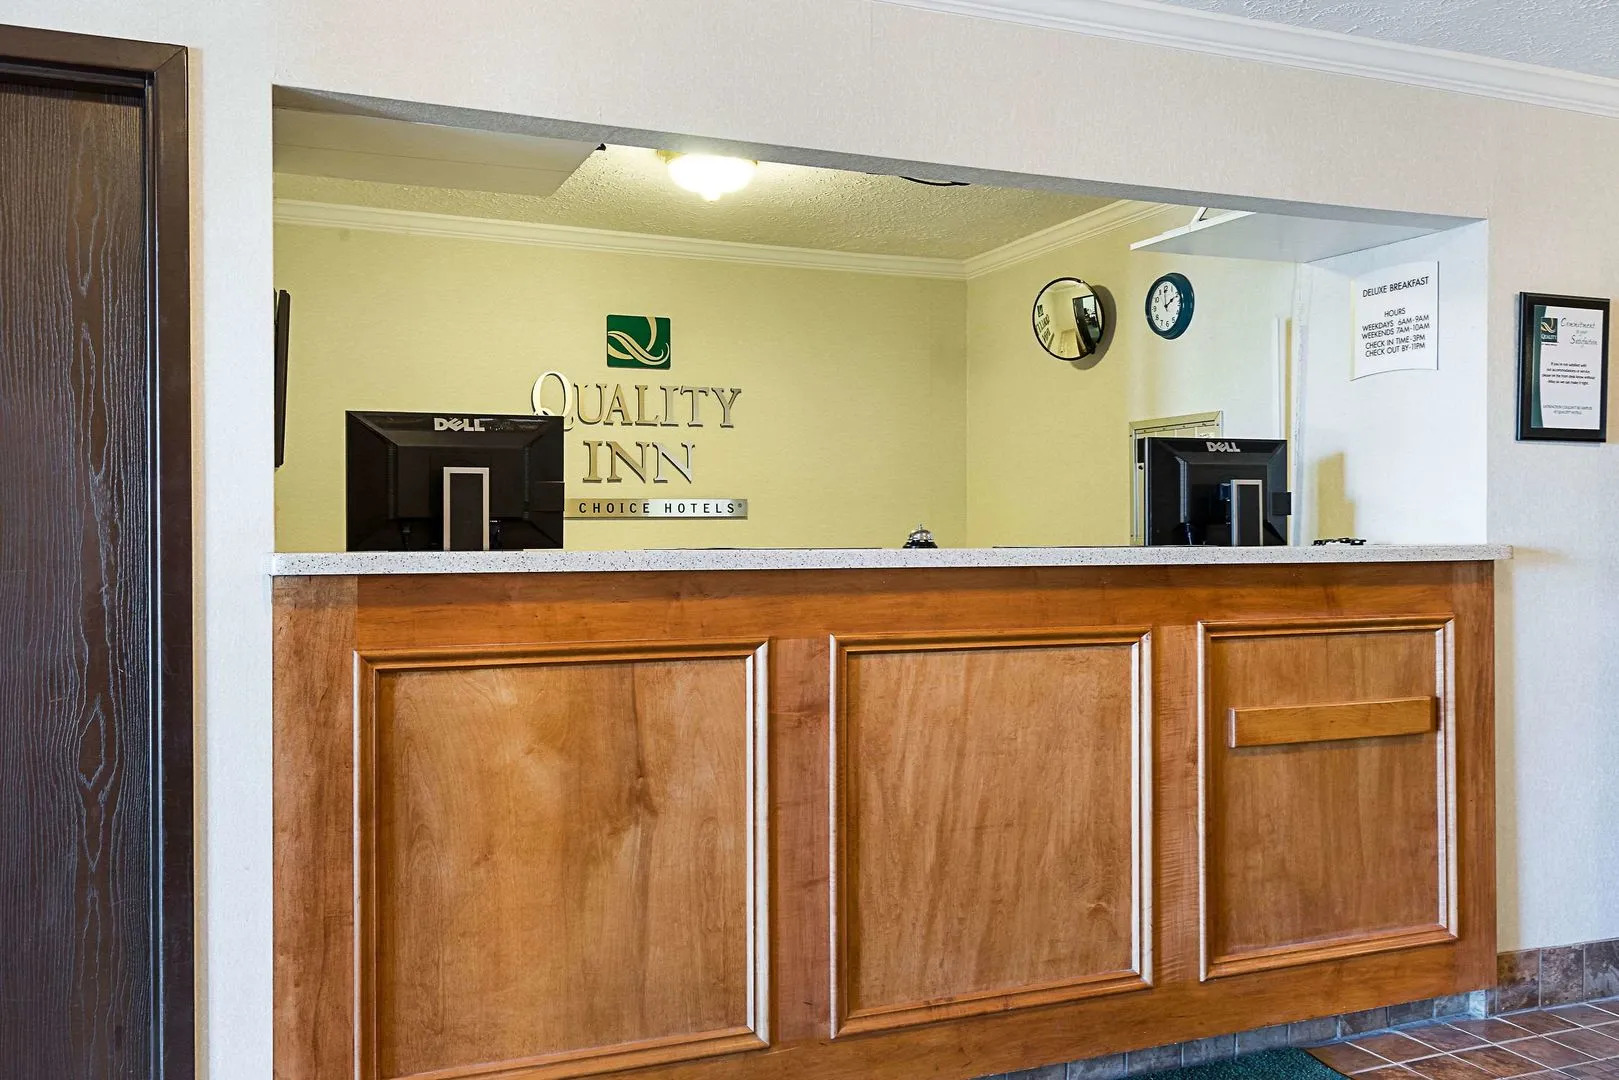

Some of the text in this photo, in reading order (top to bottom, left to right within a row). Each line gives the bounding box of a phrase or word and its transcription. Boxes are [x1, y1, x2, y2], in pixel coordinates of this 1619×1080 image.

[1362, 276, 1429, 298] DELUXE BREAKFAST
[1384, 307, 1406, 317] HOURS
[1362, 320, 1394, 331] WEEKDAYS
[1361, 328, 1394, 339] WEEKENDS
[1365, 340, 1385, 350] CHECK
[1387, 338, 1394, 346] IN
[1365, 348, 1385, 357] CHECK
[1387, 345, 1400, 354] OUT
[530, 371, 742, 431] QUALITY
[434, 417, 485, 431] DELL
[1206, 441, 1240, 452] DELL
[582, 439, 696, 484] INN
[578, 502, 650, 514] CHOICE
